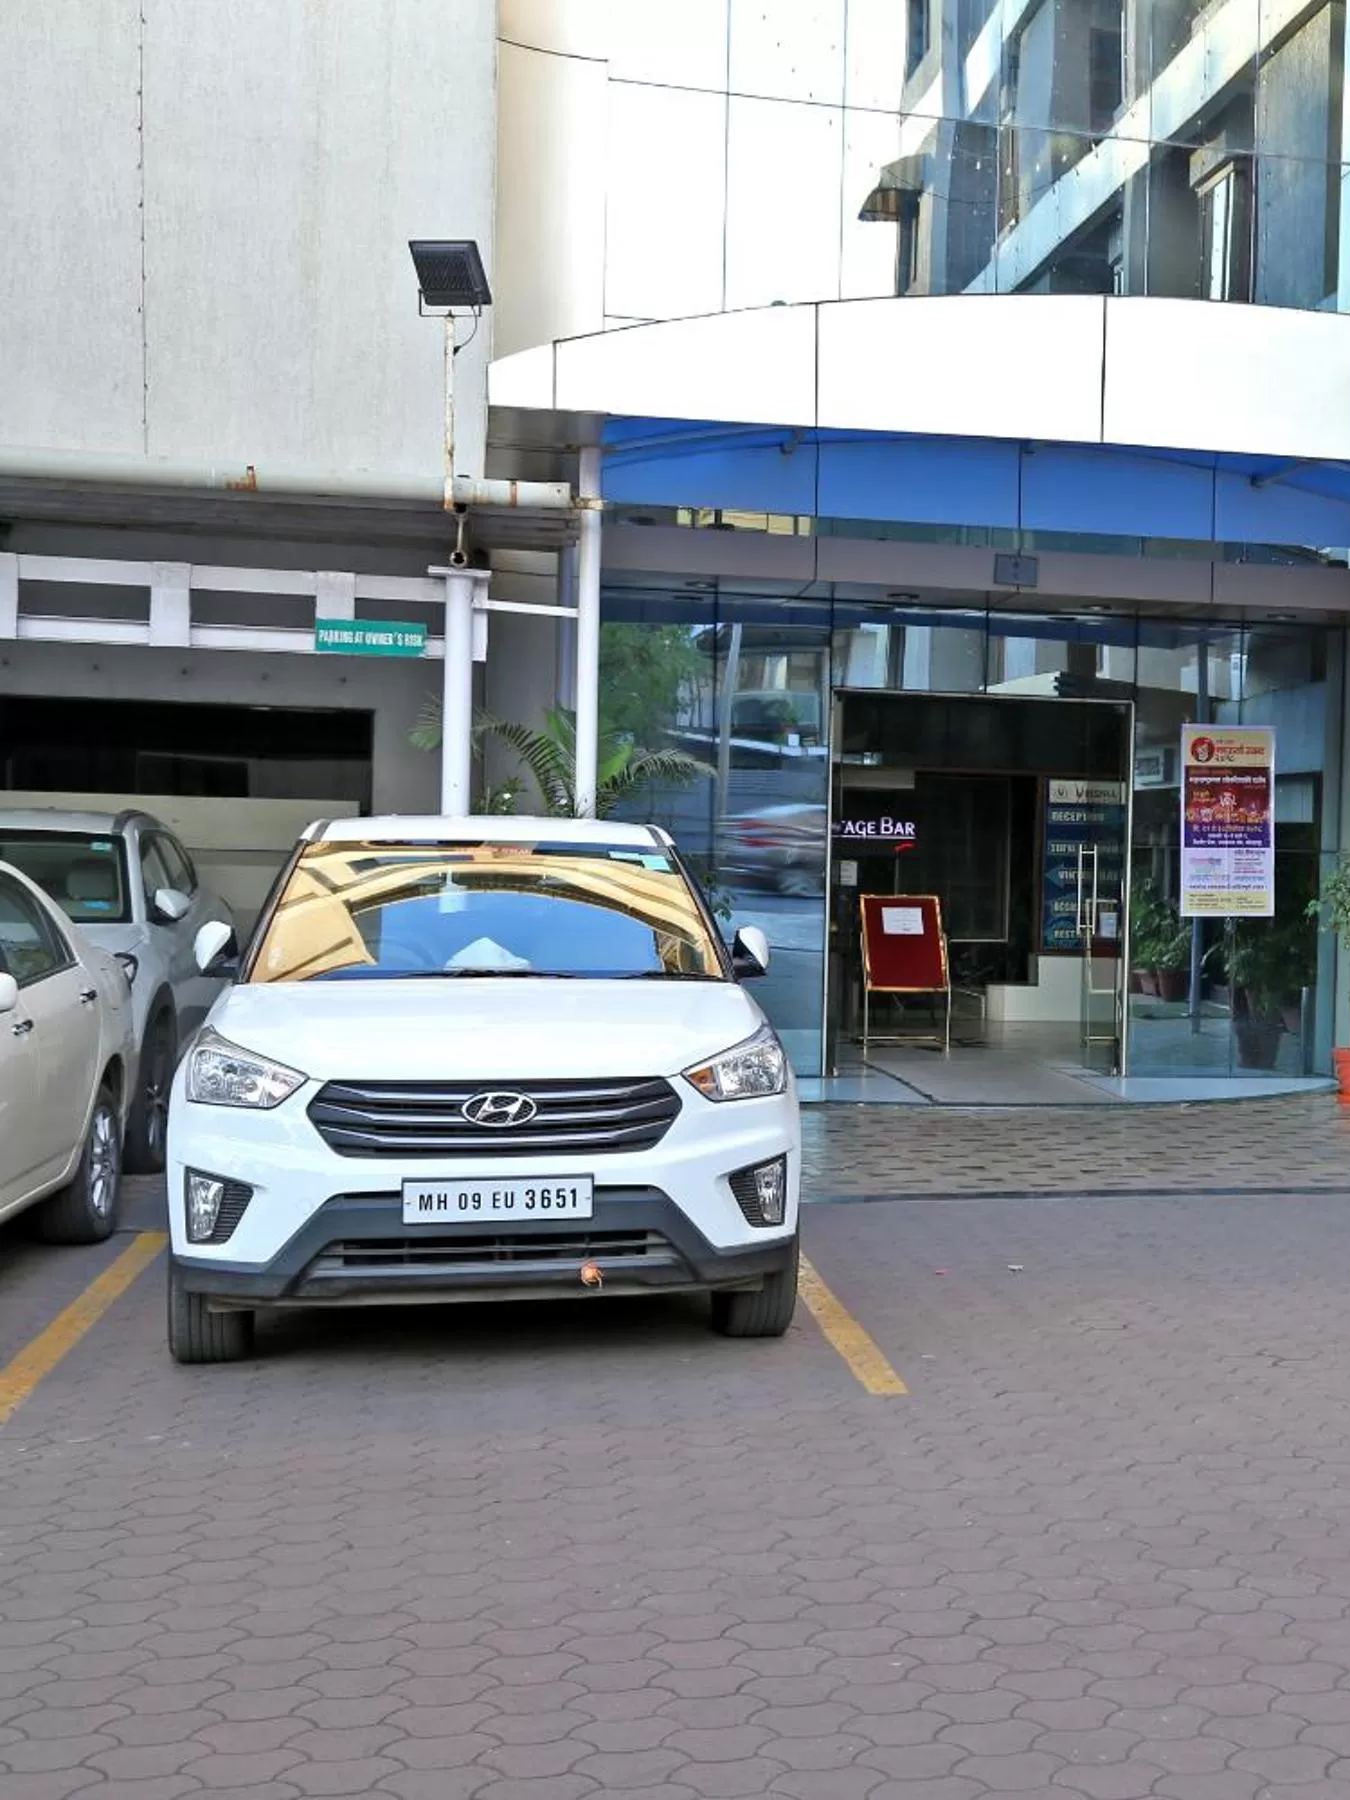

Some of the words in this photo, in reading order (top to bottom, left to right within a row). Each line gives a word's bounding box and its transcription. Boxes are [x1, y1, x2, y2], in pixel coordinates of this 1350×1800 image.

[318, 629, 354, 645] PARKING
[355, 631, 363, 644] AT
[405, 634, 423, 647] RISK
[418, 1193, 448, 1212] MH
[458, 1192, 482, 1211] 09
[492, 1191, 515, 1209] EU
[525, 1188, 578, 1210] 3651
